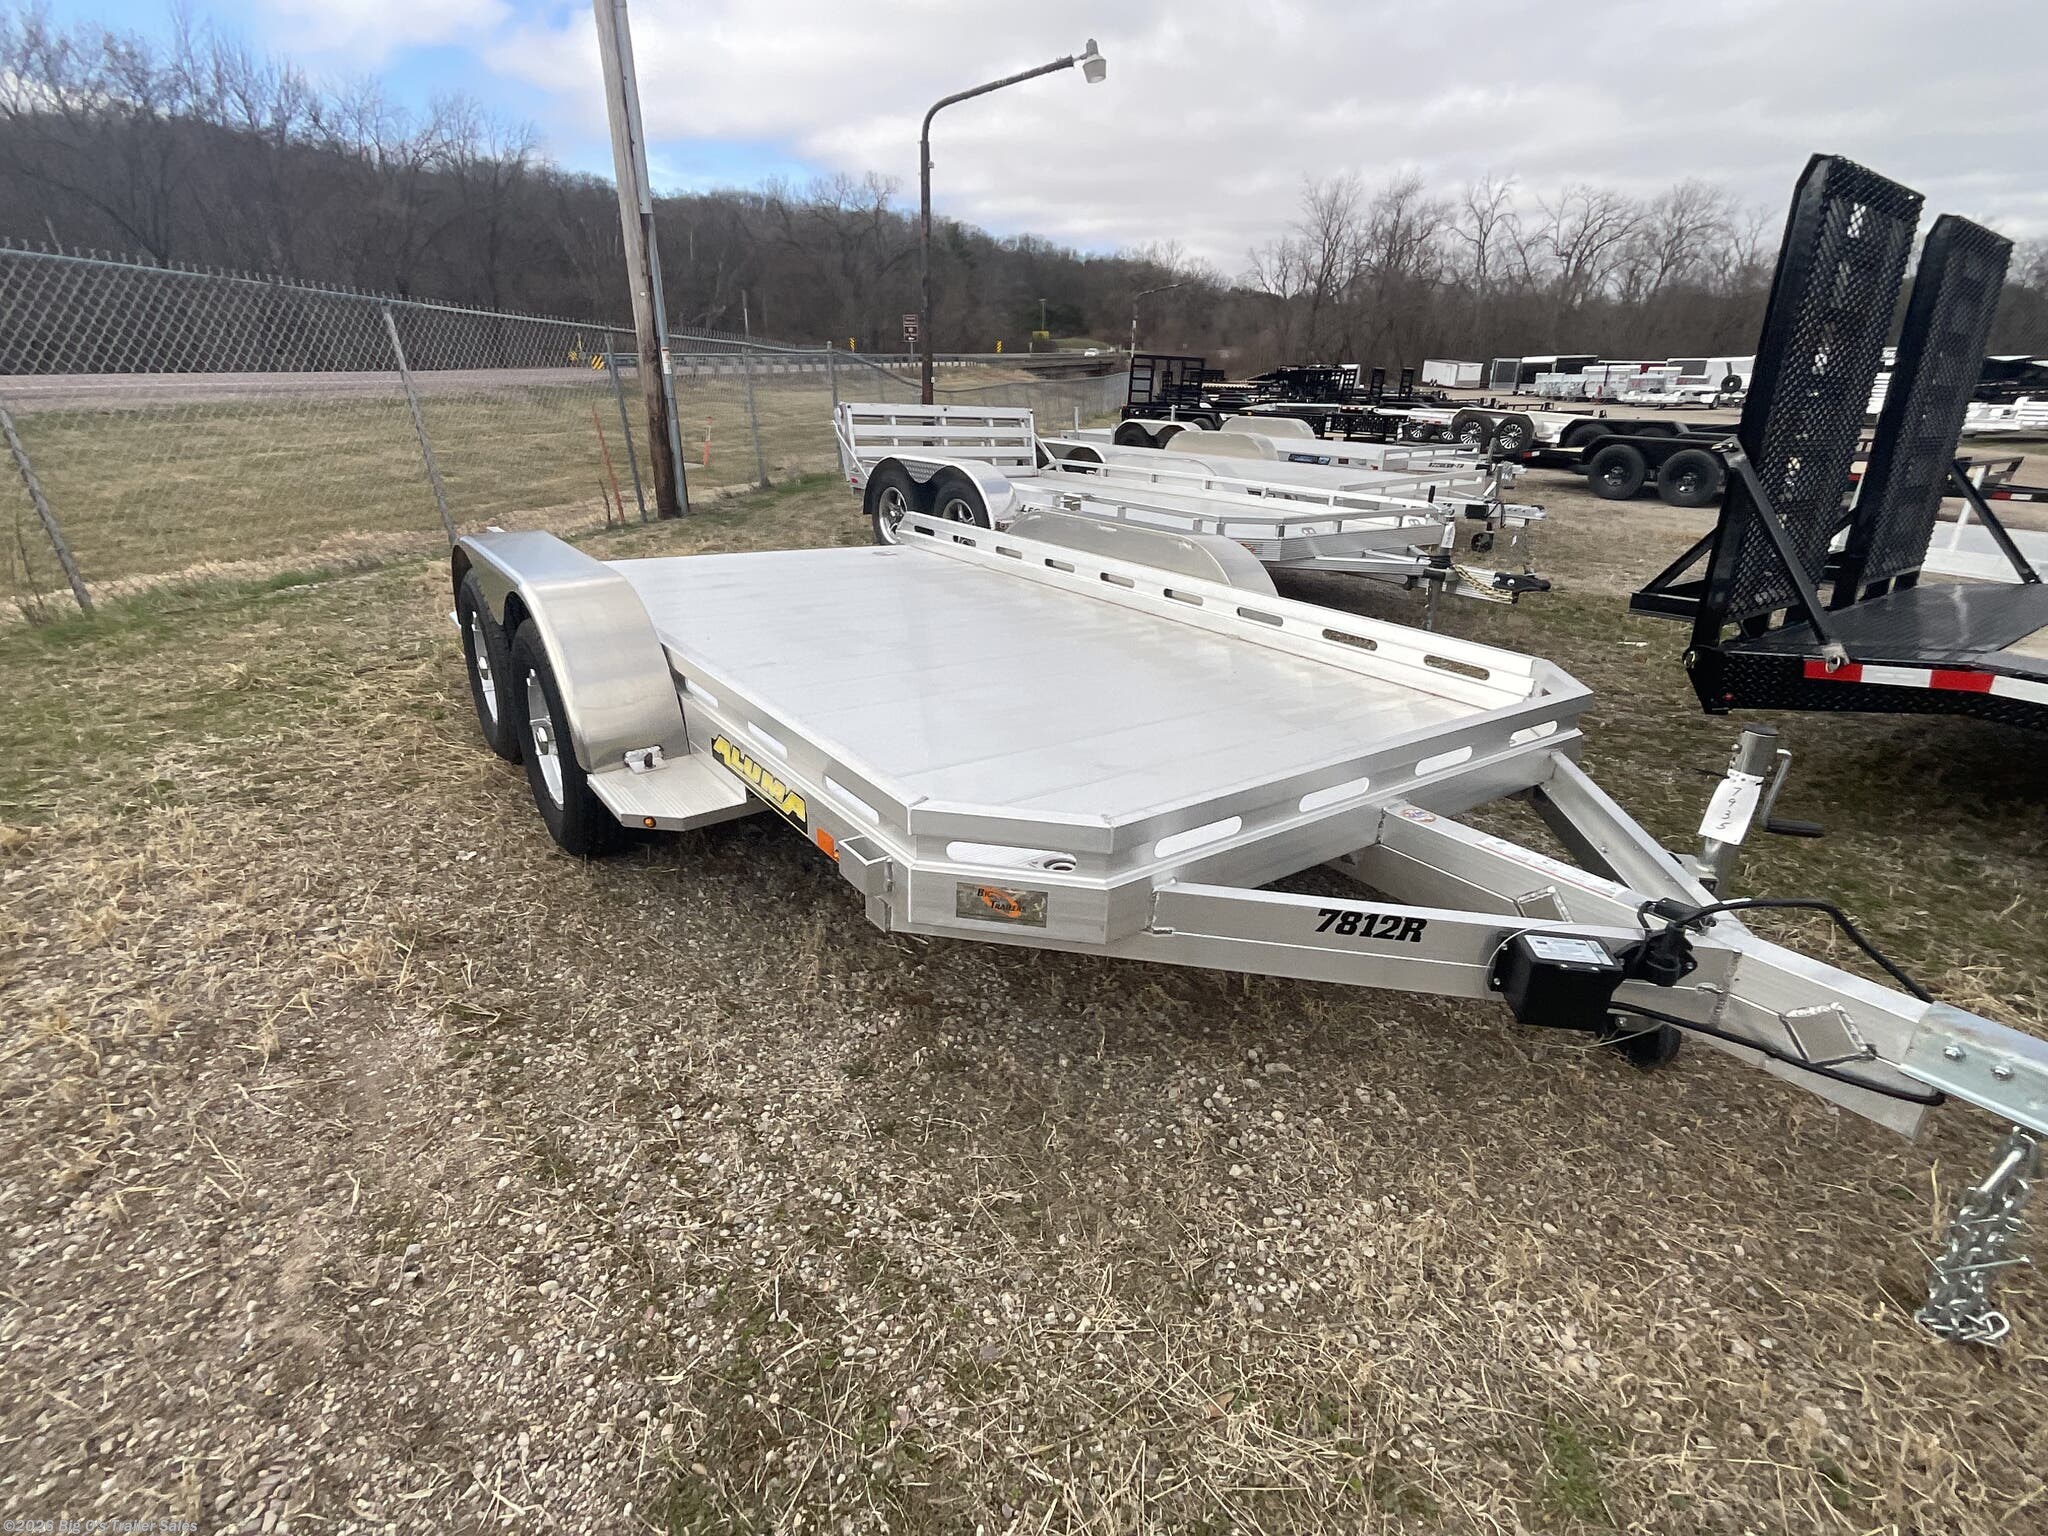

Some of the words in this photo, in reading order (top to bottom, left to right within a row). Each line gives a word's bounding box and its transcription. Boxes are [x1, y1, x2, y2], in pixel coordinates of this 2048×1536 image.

[711, 734, 807, 826] ALUMA
[1715, 786, 1743, 830] 7935
[1315, 908, 1428, 943] 7812R
